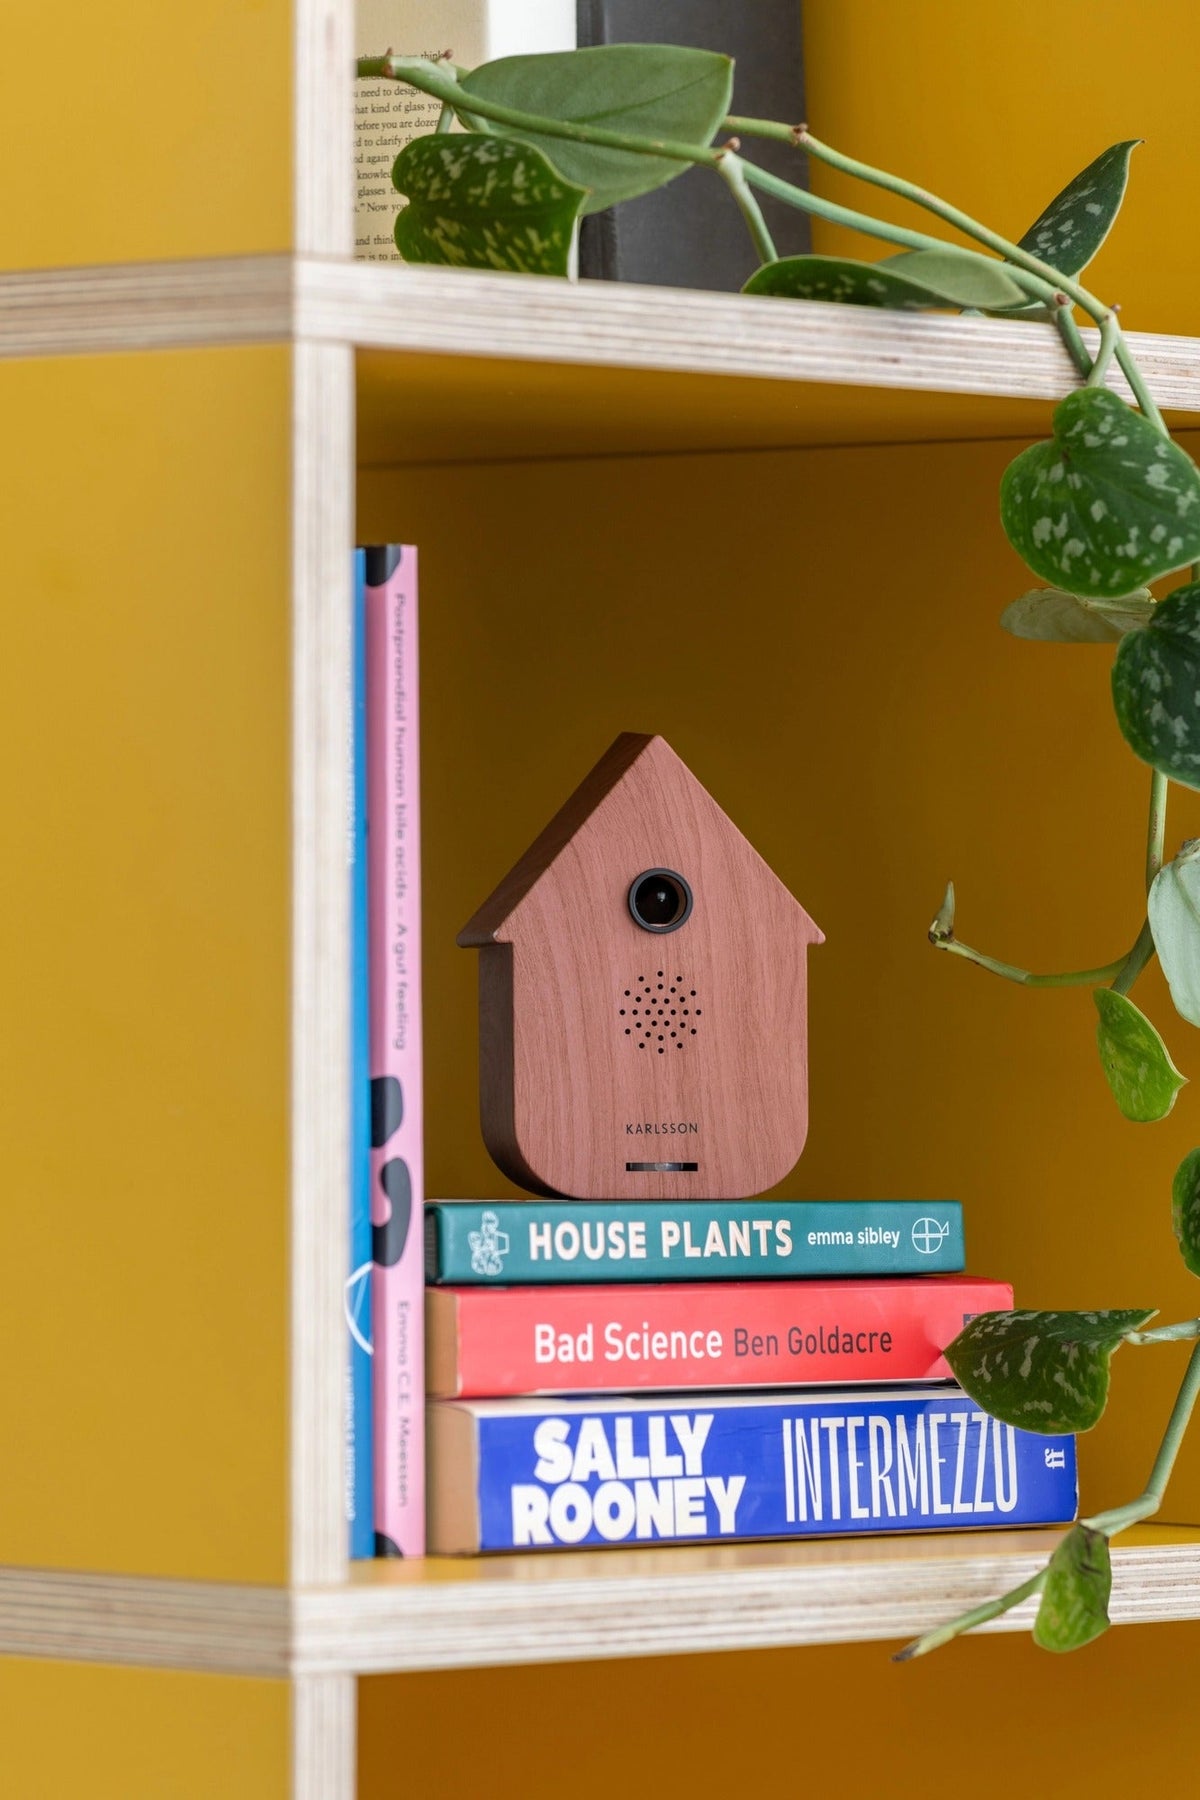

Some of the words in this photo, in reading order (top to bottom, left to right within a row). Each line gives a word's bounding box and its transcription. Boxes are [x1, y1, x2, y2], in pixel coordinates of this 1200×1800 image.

[354, 104, 368, 114] hat
[371, 102, 390, 113] kind
[393, 101, 402, 112] of
[404, 101, 425, 114] glass
[361, 86, 380, 97] need
[383, 88, 392, 96] to
[364, 138, 373, 147] to
[376, 134, 402, 147] clarify
[381, 121, 397, 131] you
[367, 153, 390, 165] again
[357, 185, 386, 199] glasses
[367, 201, 388, 213] Now
[379, 253, 388, 261] to
[393, 592, 406, 722] Postprandial
[394, 726, 407, 798] human
[395, 803, 407, 841] bile
[394, 846, 408, 899] acids
[397, 923, 408, 936] A
[393, 942, 408, 975] gut
[393, 981, 409, 1051] feeling
[626, 1122, 698, 1135] KARLSSON
[528, 1220, 647, 1261] HOUSE
[660, 1219, 793, 1258] PLANTS
[807, 1228, 854, 1246] emma
[857, 1226, 901, 1249] sibley
[398, 1300, 410, 1366] Emma
[534, 1322, 593, 1364] Bad
[604, 1320, 723, 1361] Science
[734, 1327, 779, 1357] Ben
[787, 1325, 892, 1355] Goldacre
[533, 1414, 715, 1485] SALLY
[782, 1411, 1018, 1523] INTERMEZZO
[511, 1475, 747, 1546] ROONEY
